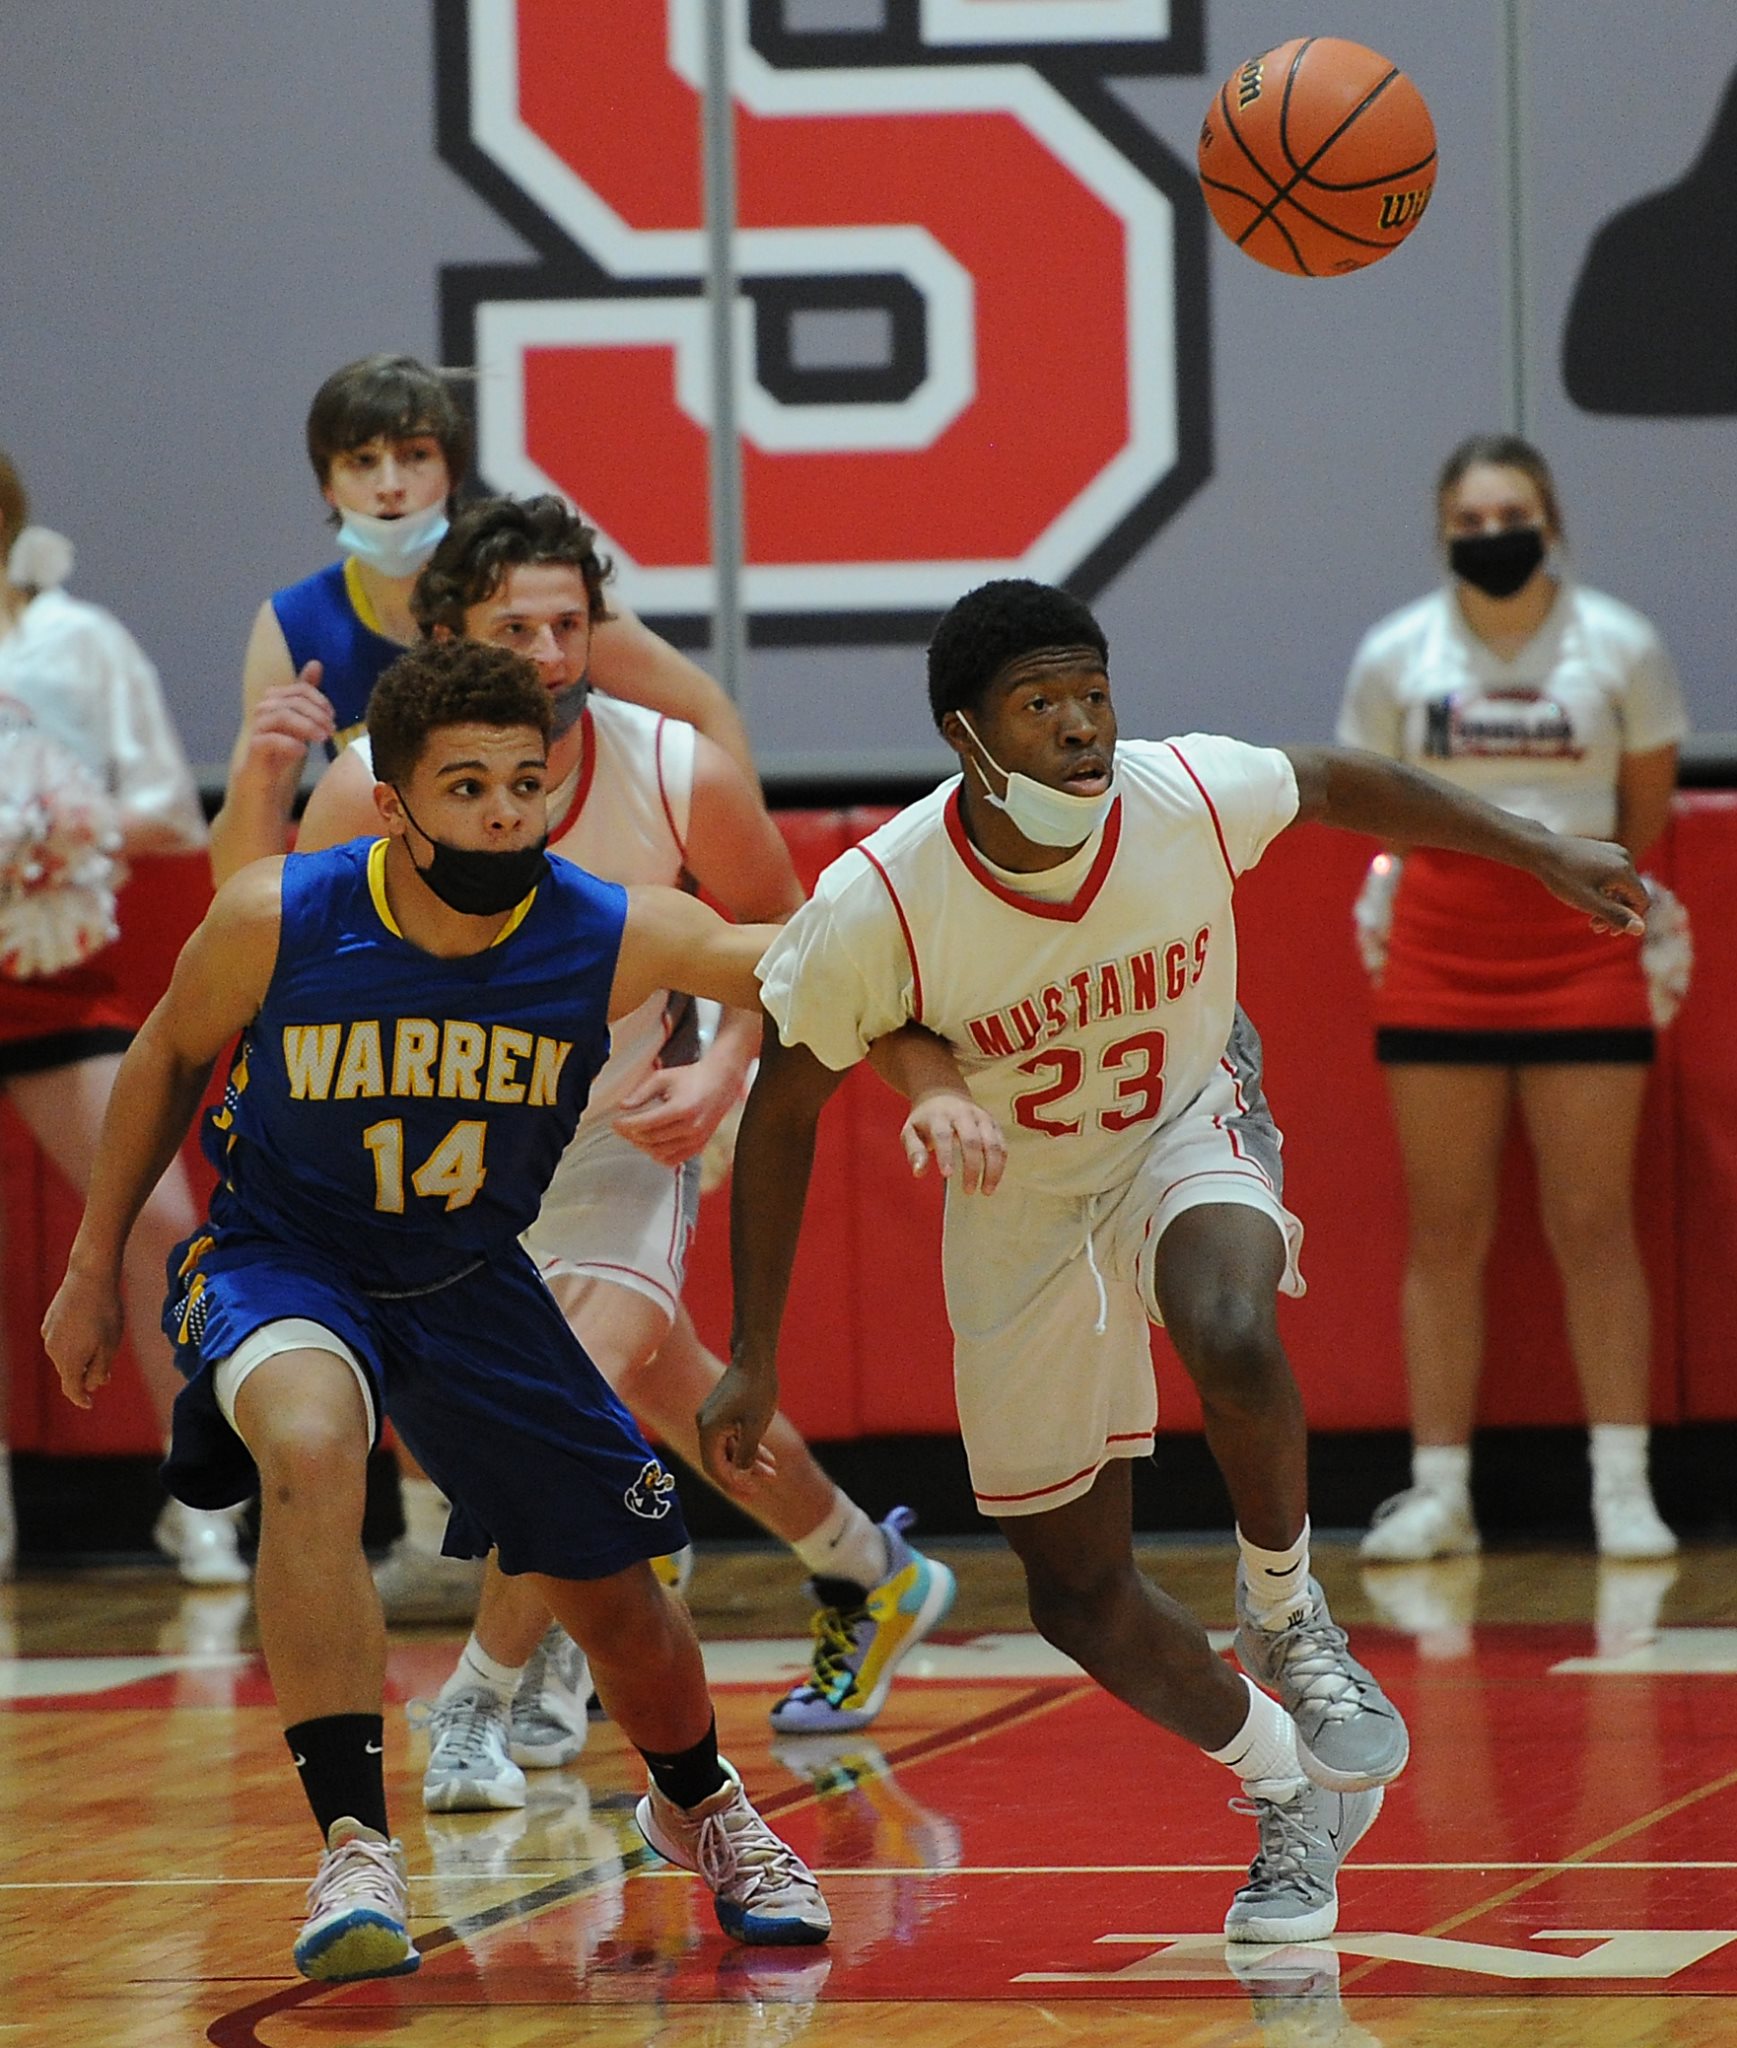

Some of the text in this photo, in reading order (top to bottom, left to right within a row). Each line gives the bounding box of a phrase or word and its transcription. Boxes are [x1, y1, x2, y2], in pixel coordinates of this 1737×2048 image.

[964, 923, 1212, 1058] MUSTANGS
[283, 1018, 574, 1106] WARREN
[1011, 1028, 1168, 1137] 23
[363, 1118, 488, 1214] 14
